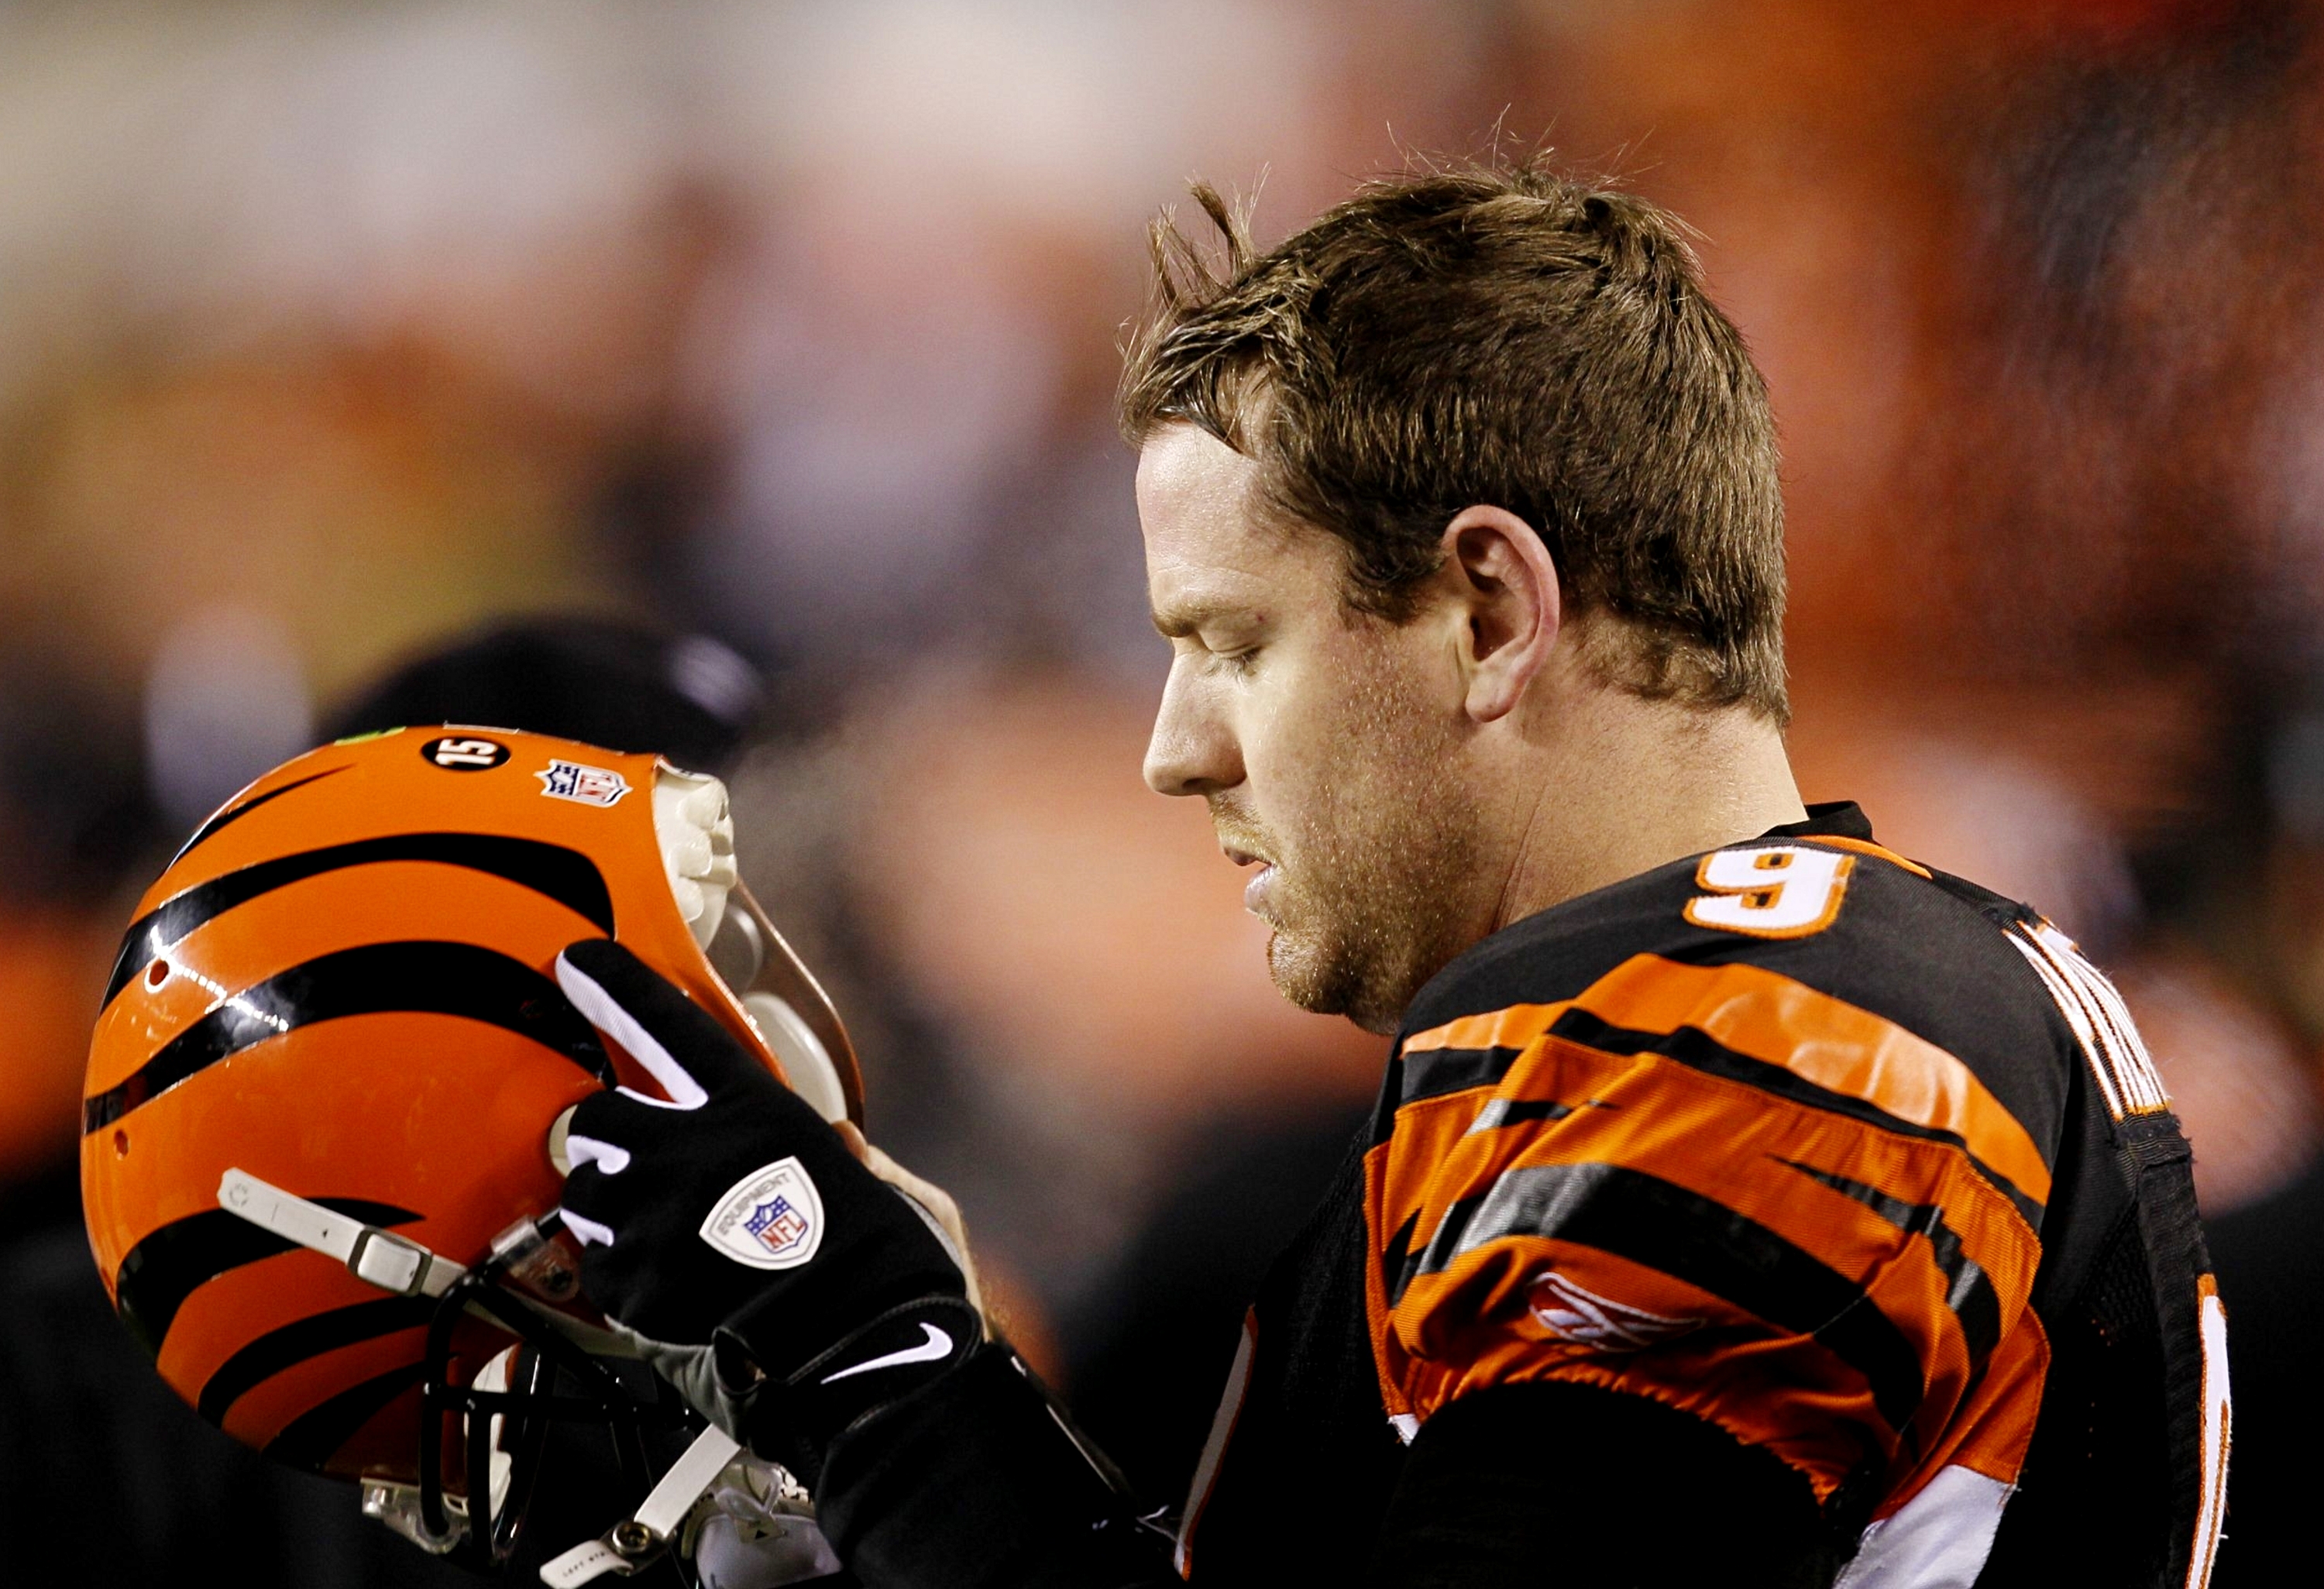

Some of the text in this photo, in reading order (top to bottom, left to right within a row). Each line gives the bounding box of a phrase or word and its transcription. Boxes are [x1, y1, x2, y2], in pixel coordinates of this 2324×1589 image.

[435, 738, 498, 765] 15
[1683, 844, 1856, 939] 9
[717, 1172, 790, 1236] EQUIPMENT
[761, 1214, 804, 1249] NFL
